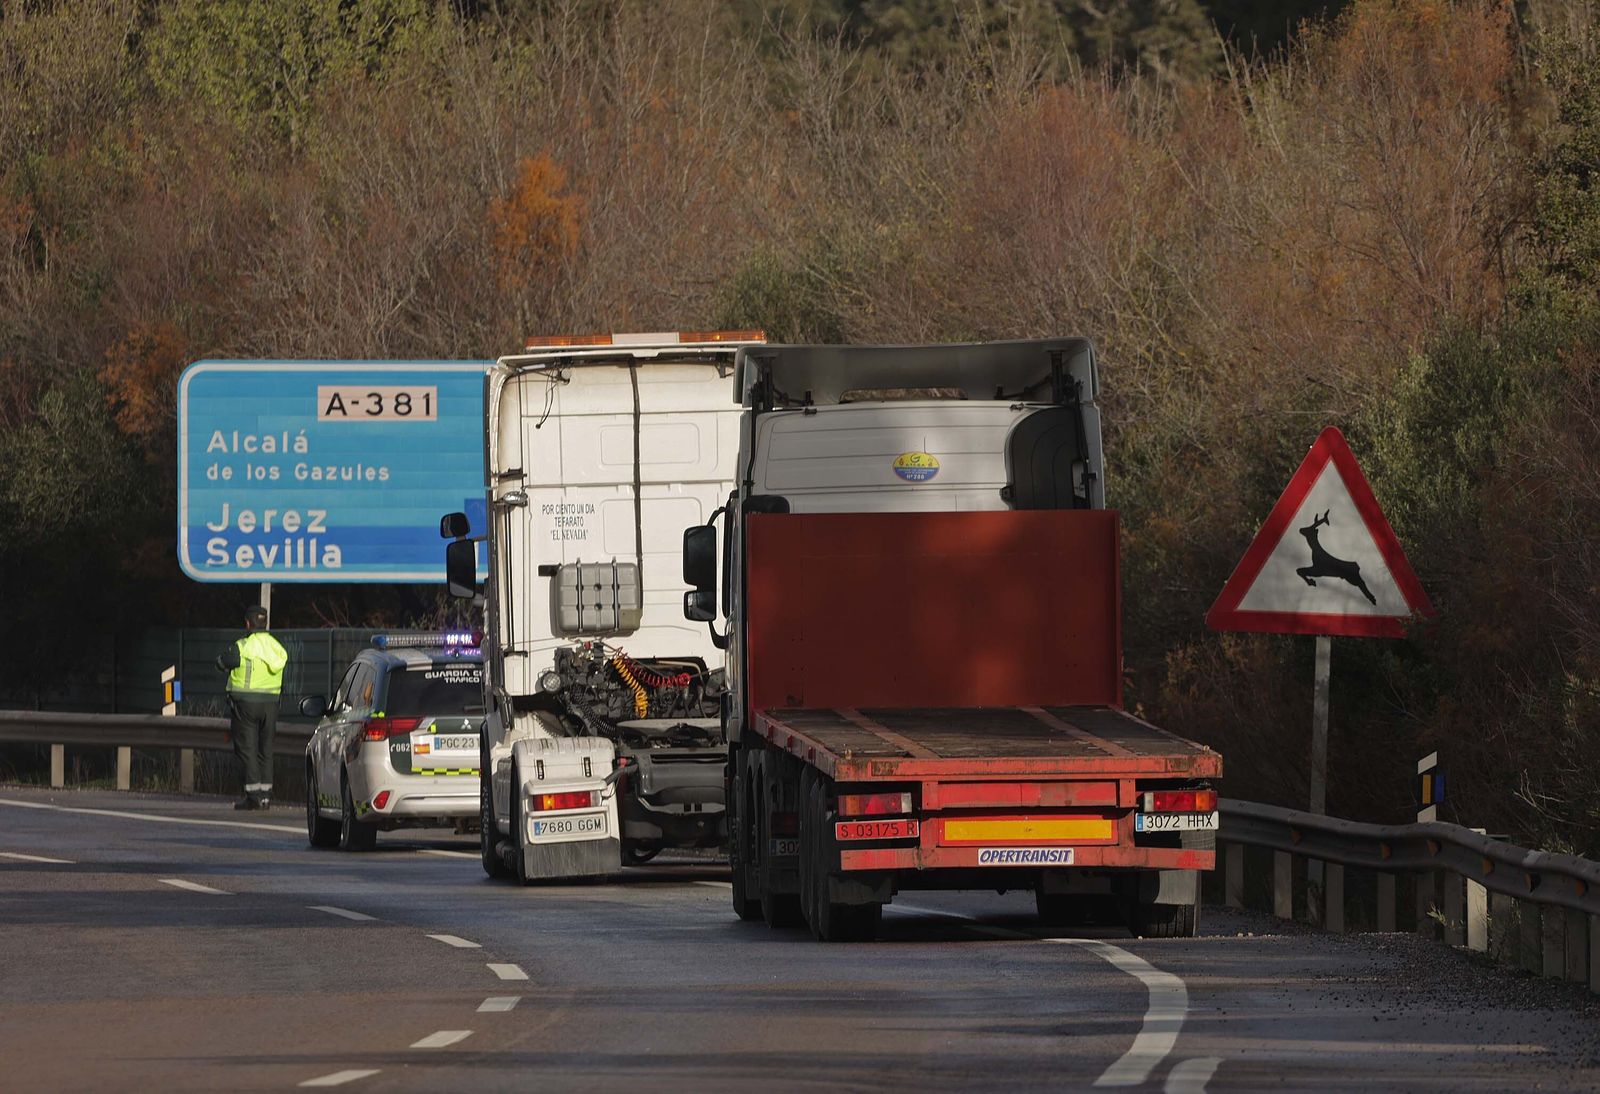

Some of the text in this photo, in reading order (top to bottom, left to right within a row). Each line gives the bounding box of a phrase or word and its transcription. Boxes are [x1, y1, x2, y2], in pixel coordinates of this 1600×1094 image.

[325, 392, 431, 416] A-381
[206, 429, 309, 454] Alcalá
[206, 462, 390, 481] de los Gazules
[541, 504, 555, 515] POR
[576, 503, 585, 514] UN
[206, 502, 327, 533] Jerez
[206, 537, 342, 568] Sevilla
[424, 669, 482, 679] GUARDIA CI
[396, 743, 410, 752] 062
[440, 737, 460, 749] PGC
[541, 819, 601, 833] 7680 GGM
[1146, 814, 1213, 828] 3072 HHX
[841, 822, 915, 837] S 03175 R
[979, 849, 1072, 863] OPERTRANSIT
